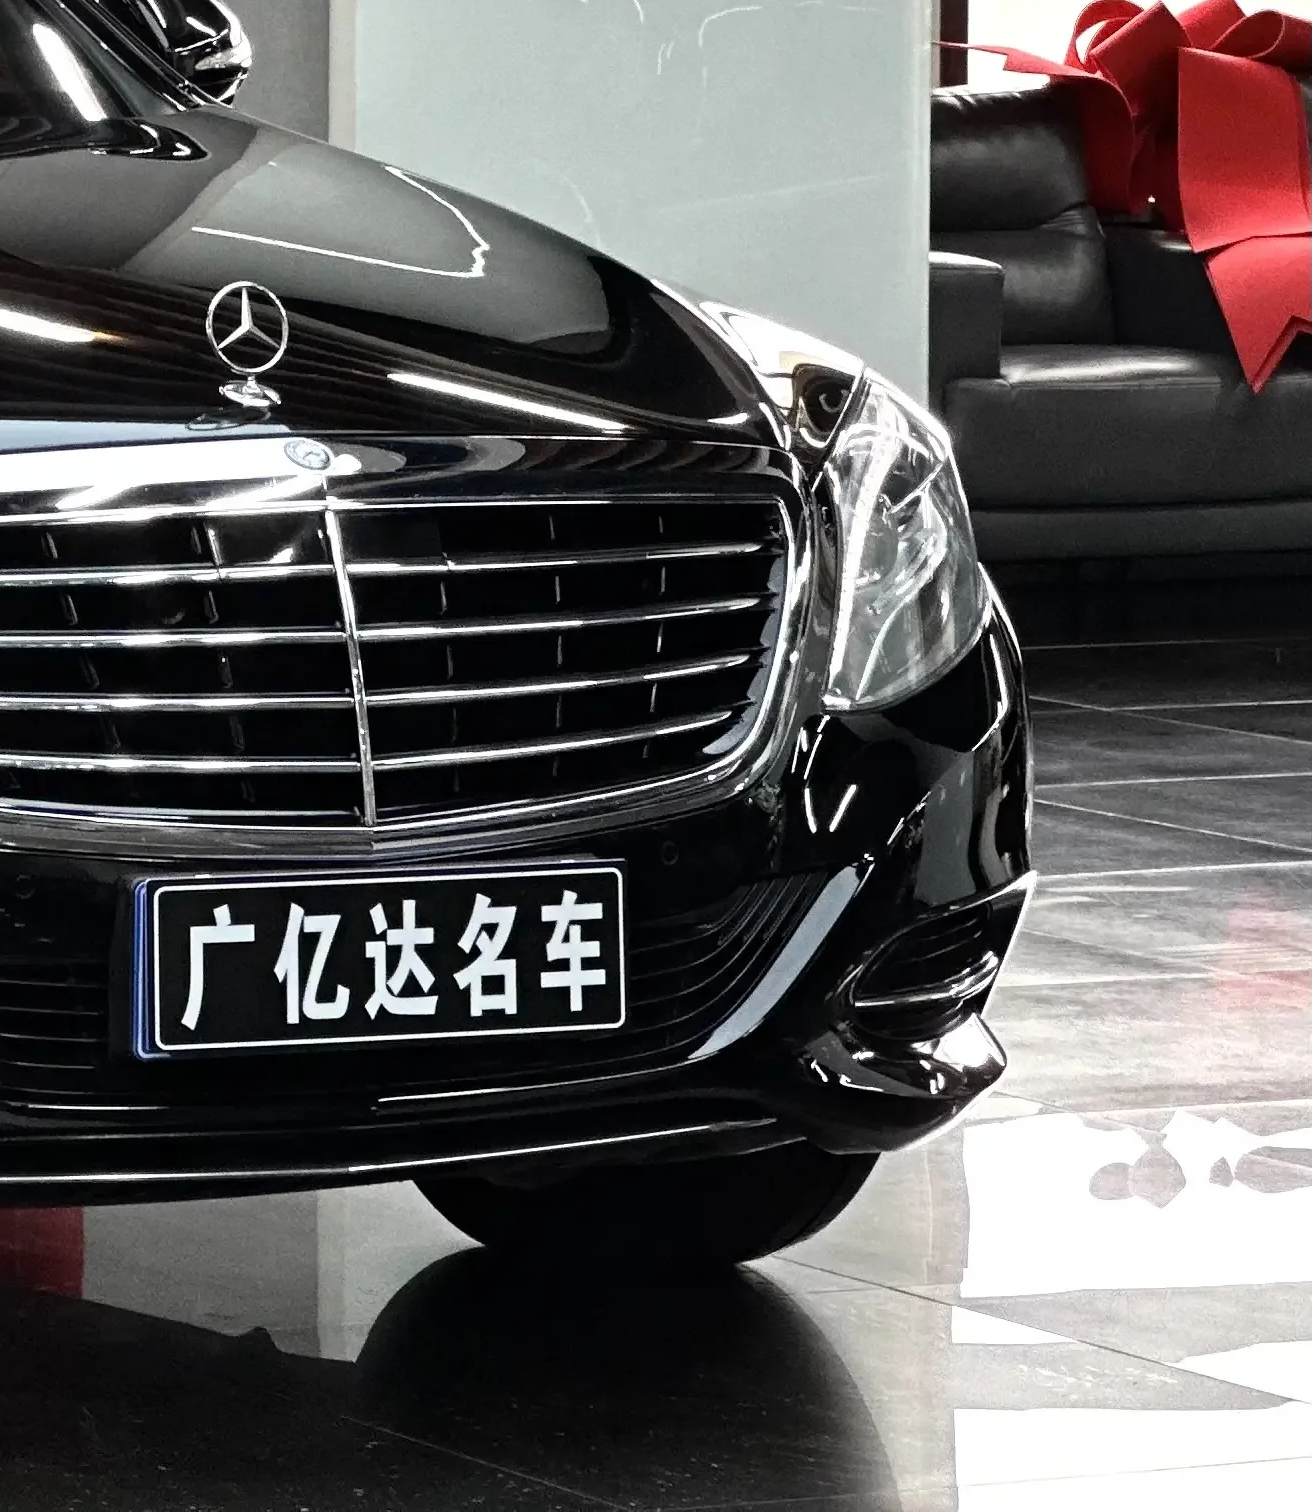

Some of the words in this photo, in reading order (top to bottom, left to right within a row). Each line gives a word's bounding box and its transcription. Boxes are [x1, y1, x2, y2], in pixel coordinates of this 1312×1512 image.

[181, 891, 607, 1030] 广亿达名车
